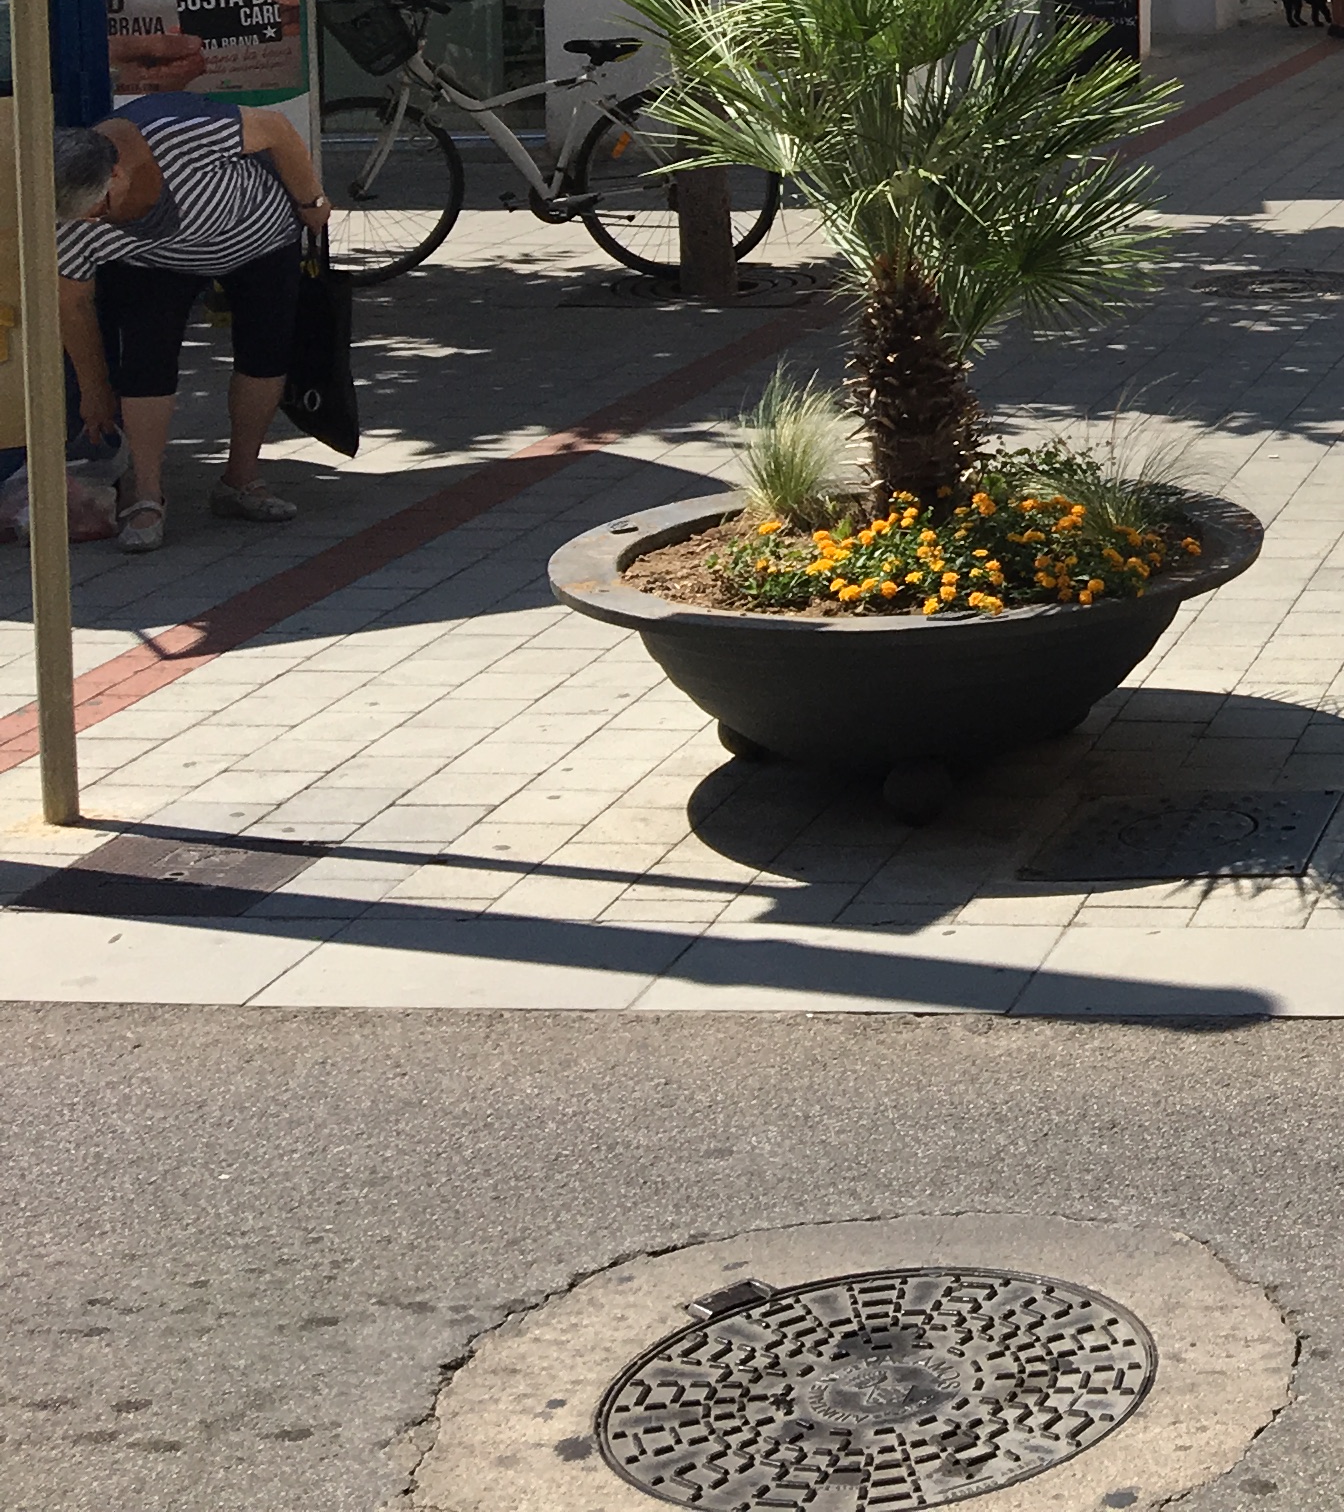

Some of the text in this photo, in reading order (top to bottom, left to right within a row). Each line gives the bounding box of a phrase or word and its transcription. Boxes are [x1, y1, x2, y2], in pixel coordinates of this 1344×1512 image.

[109, 15, 167, 37] BRAVA
[200, 35, 260, 51] TA BRAVA
